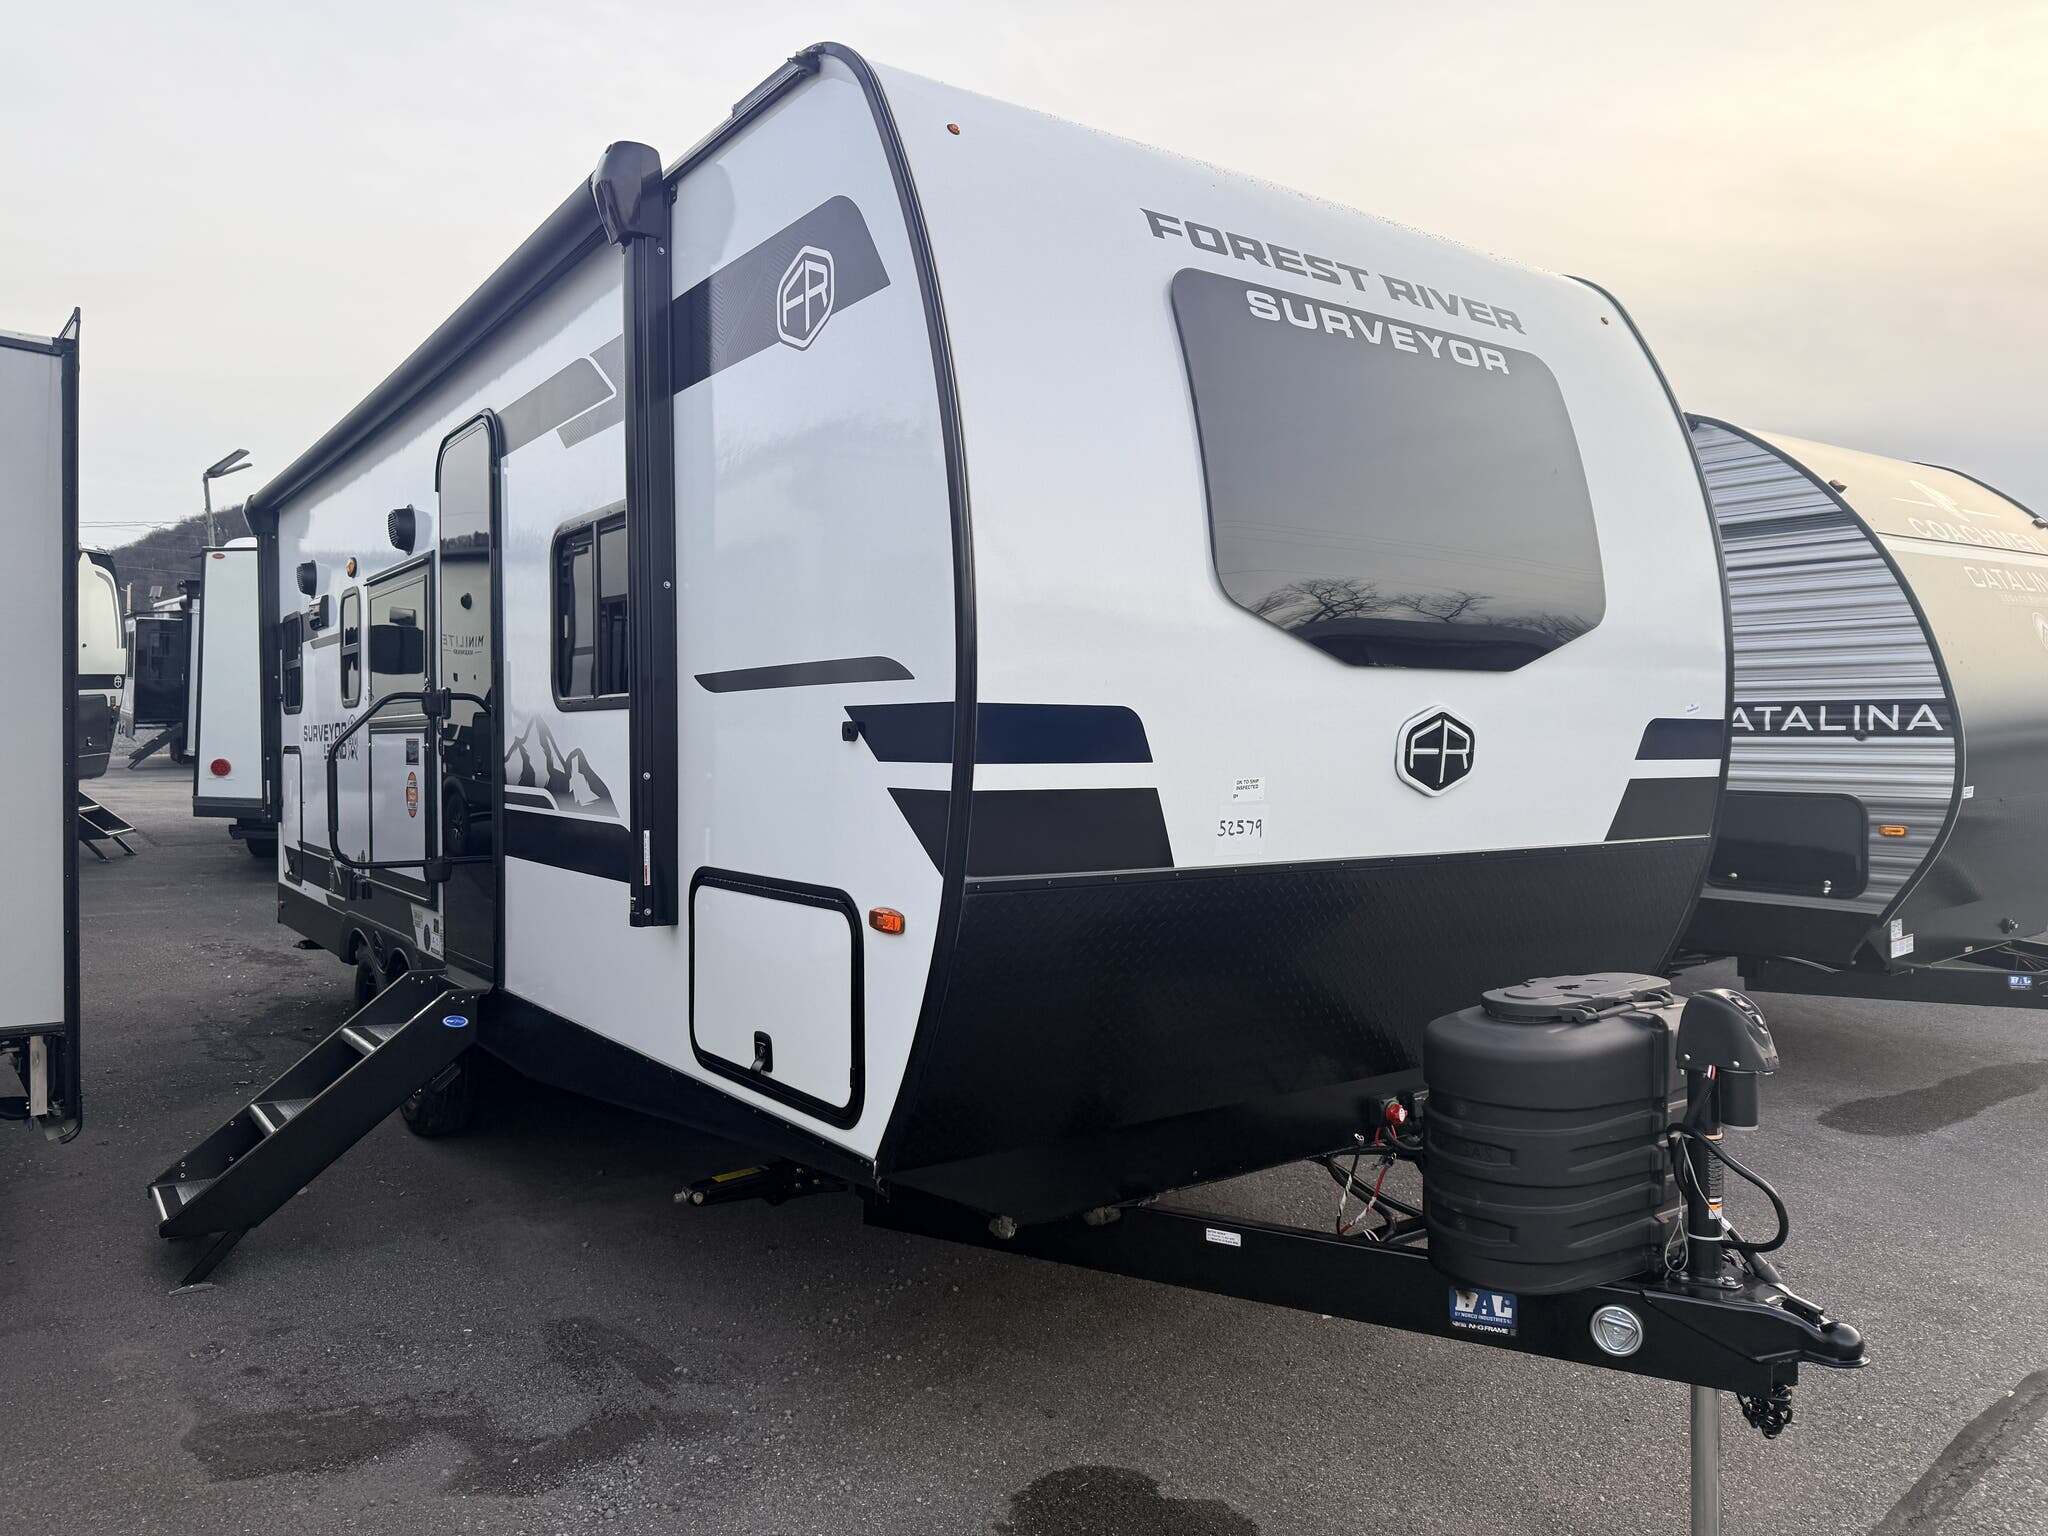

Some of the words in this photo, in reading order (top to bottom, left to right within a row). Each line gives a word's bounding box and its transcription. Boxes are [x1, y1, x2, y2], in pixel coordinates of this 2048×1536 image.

[1140, 208, 1368, 292] FOREST
[1378, 273, 1528, 335] RIVER
[1246, 290, 1510, 375] SURVEYOR
[1217, 818, 1263, 838] 52579
